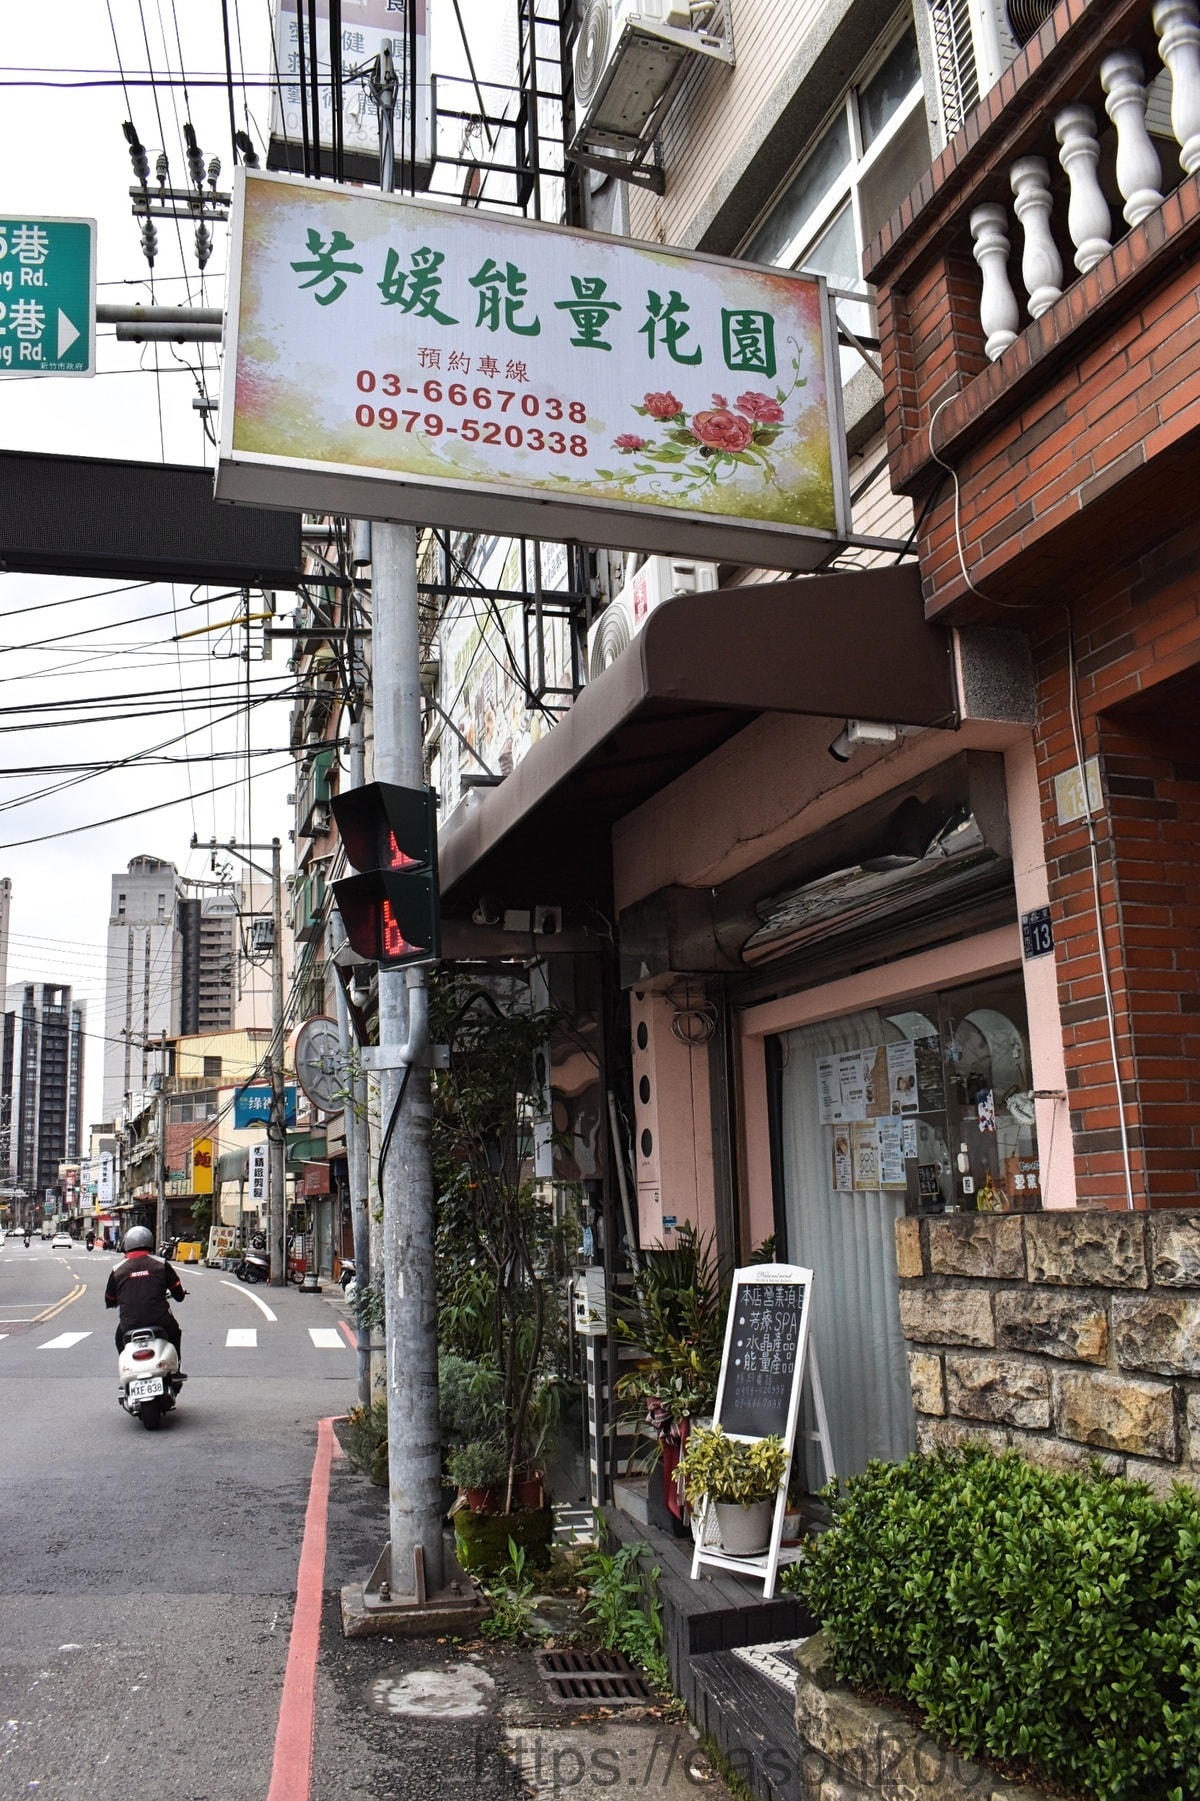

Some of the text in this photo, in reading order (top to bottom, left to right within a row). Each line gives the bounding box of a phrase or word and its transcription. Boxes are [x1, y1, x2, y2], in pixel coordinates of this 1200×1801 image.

[20, 267, 48, 287] Rd.
[290, 228, 778, 380] 芳媛能量花園
[19, 341, 47, 361] Rd.
[417, 347, 531, 383] 預約專線
[356, 370, 588, 424] 03-6667038
[354, 404, 589, 458] 0979-520338
[1032, 923, 1051, 951] 13
